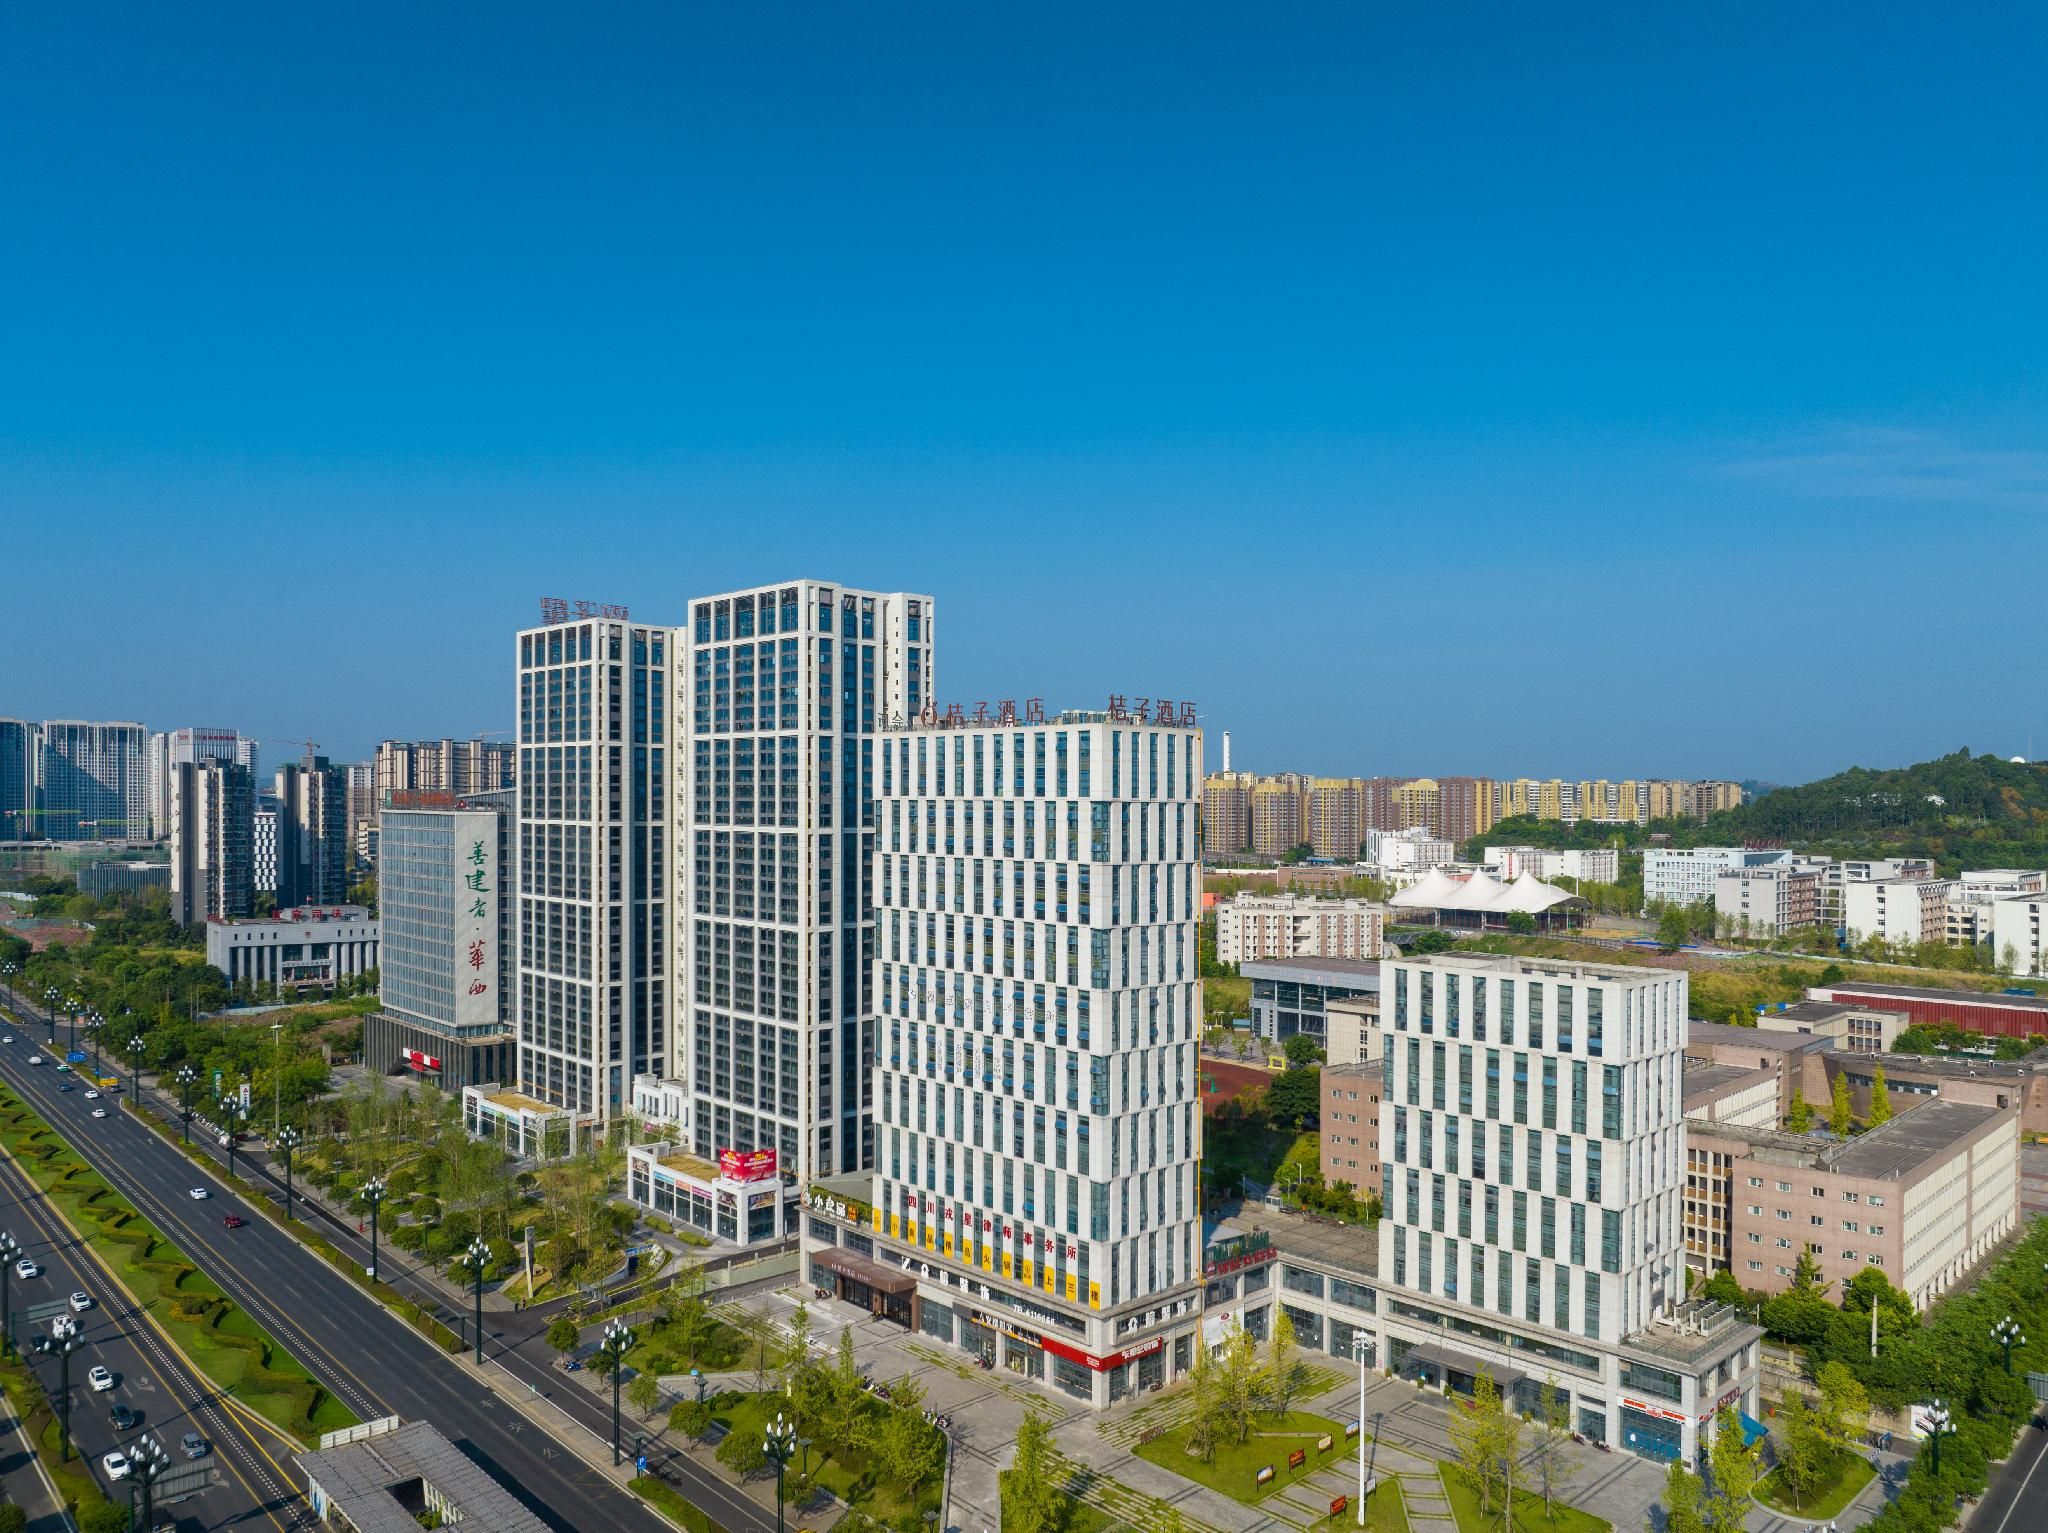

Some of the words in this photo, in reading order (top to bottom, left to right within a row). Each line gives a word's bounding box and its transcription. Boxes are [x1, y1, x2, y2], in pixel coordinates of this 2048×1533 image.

[947, 697, 1044, 729] 桔子酒店
[1108, 694, 1197, 729] 桔子酒店
